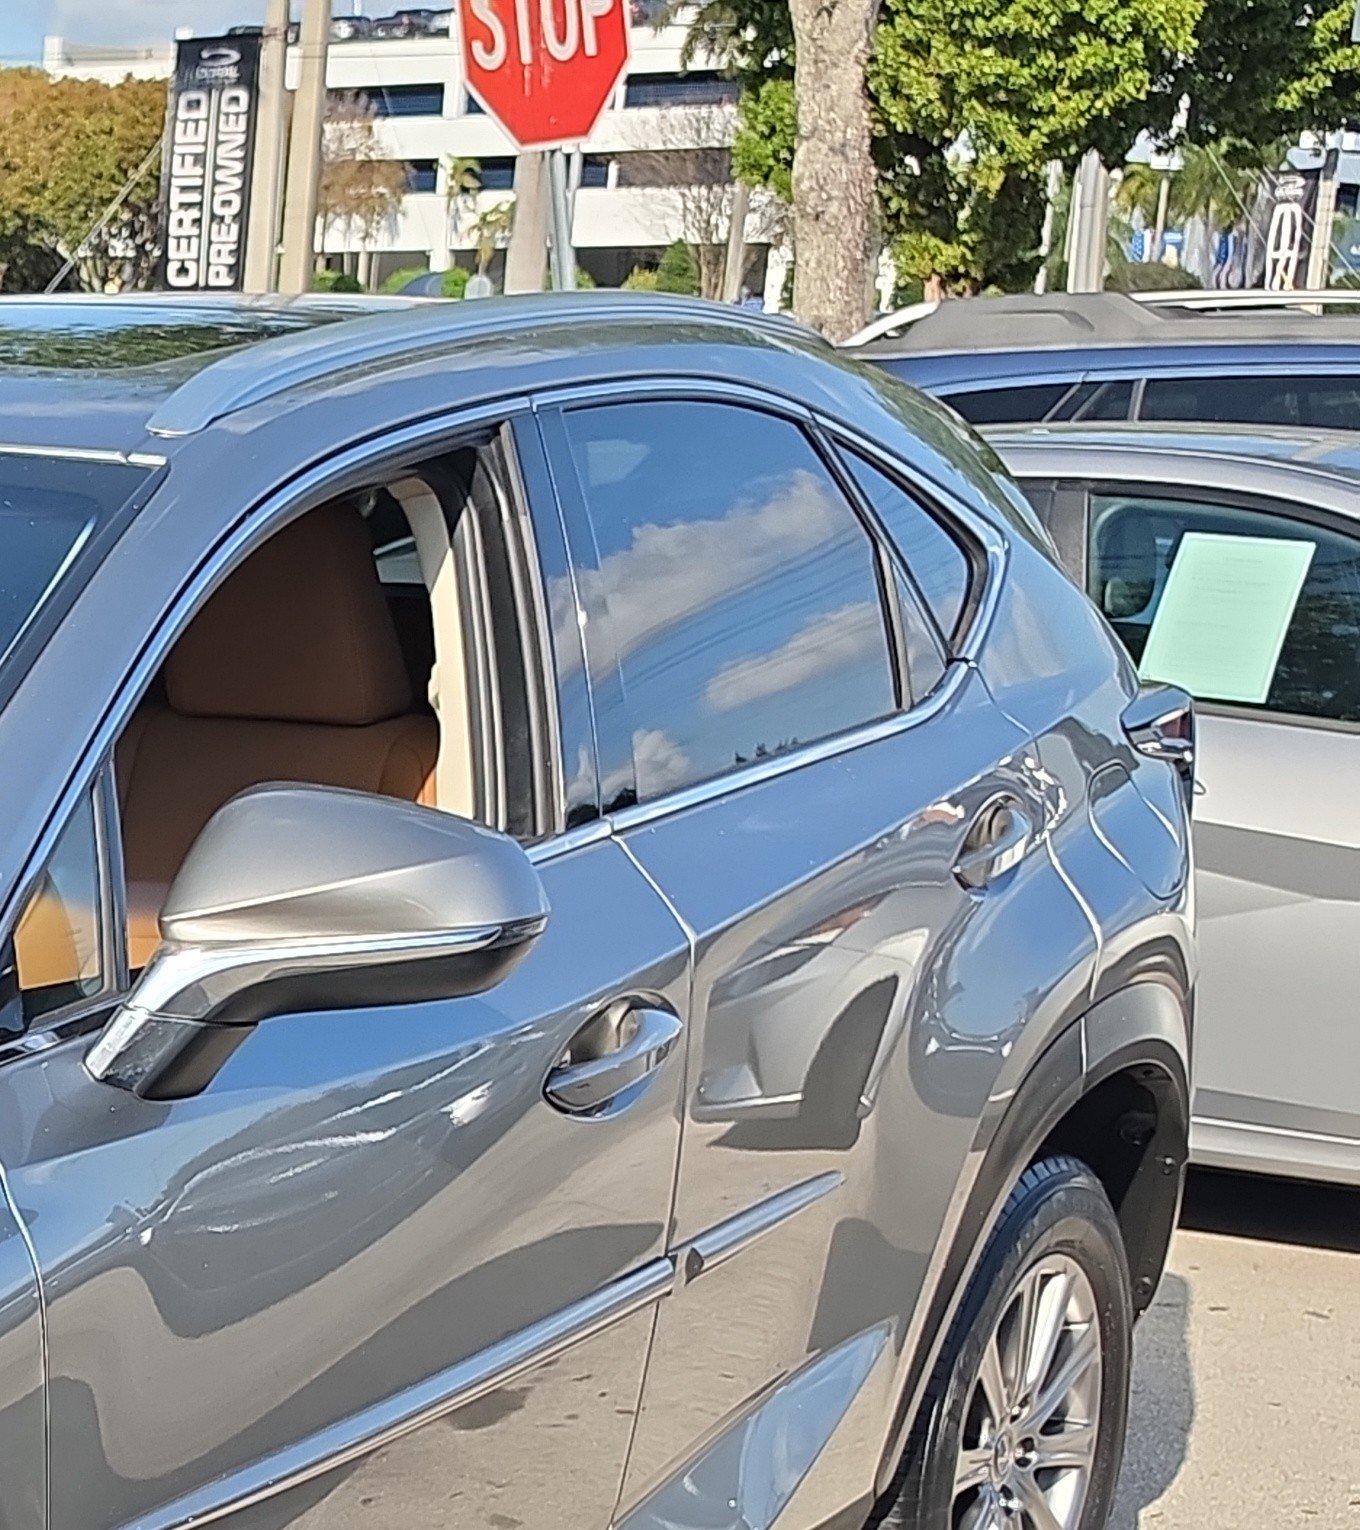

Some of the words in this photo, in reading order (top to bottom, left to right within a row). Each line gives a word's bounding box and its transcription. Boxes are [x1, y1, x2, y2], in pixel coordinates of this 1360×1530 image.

[470, 0, 614, 71] STOP
[166, 90, 210, 288] CERTIFIED
[207, 84, 250, 287] PRE-OWNED
